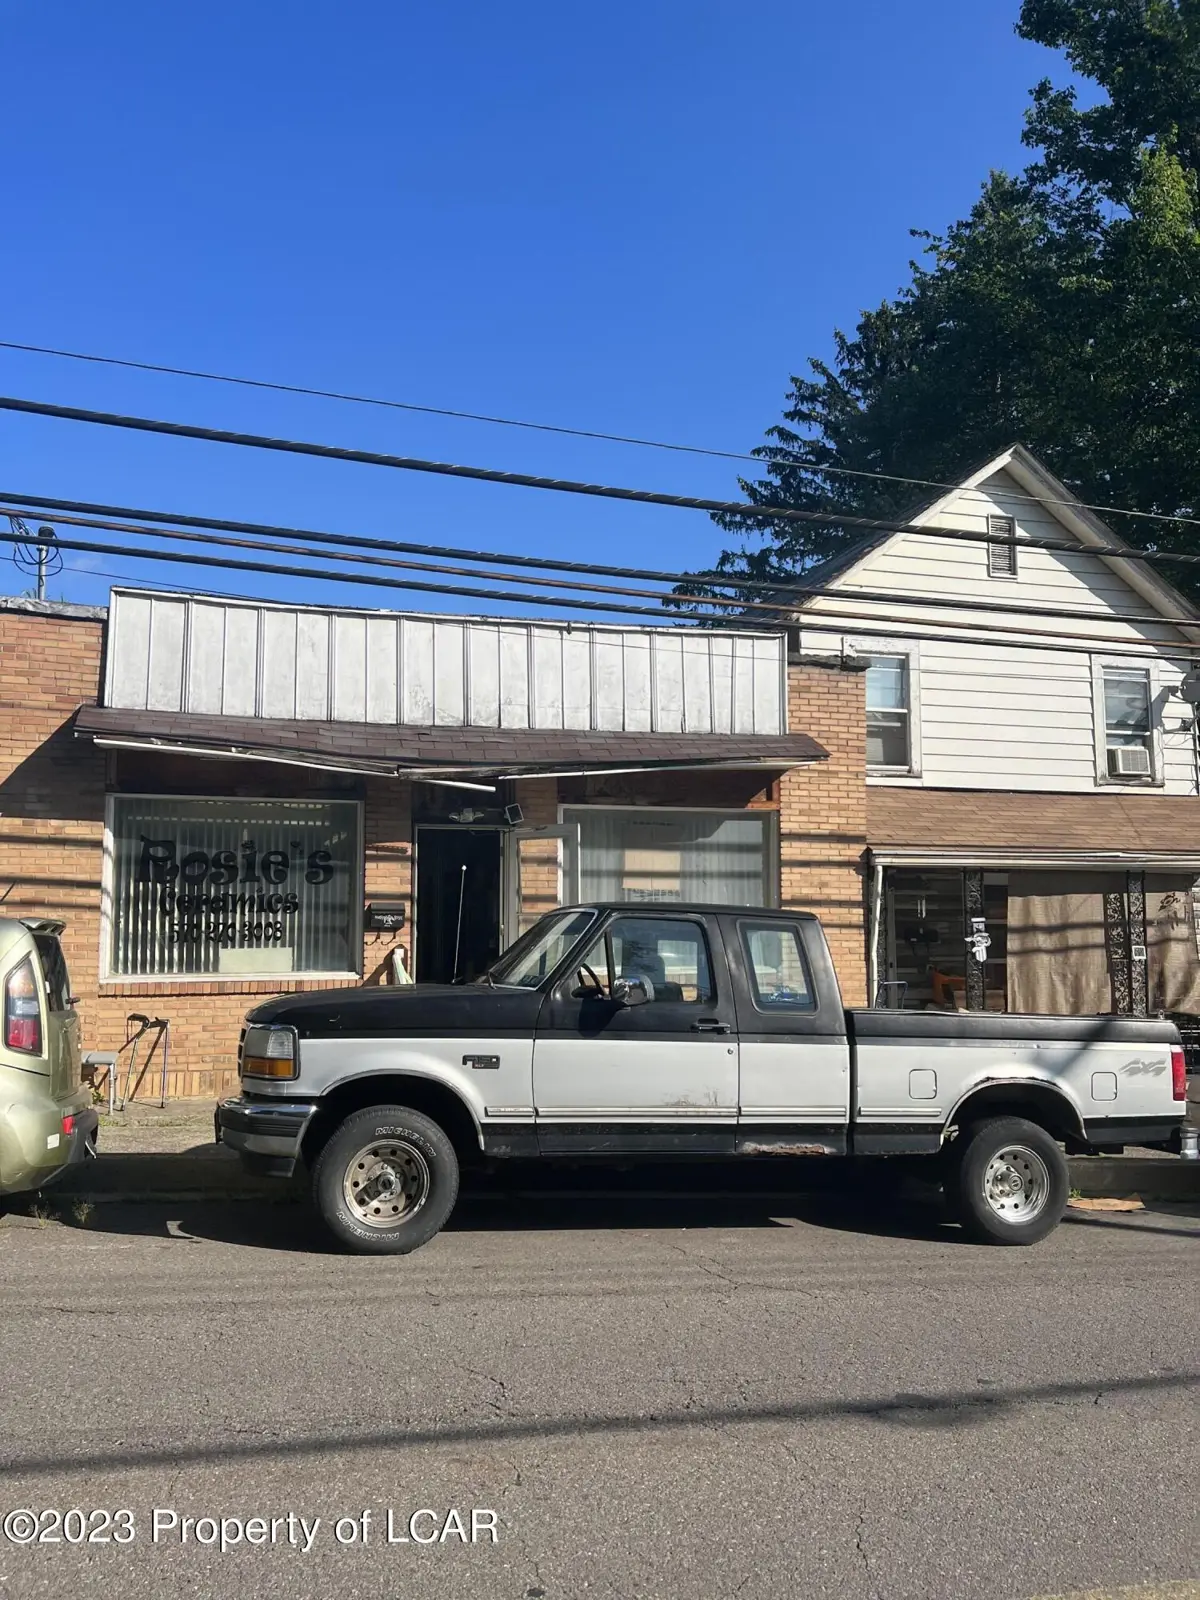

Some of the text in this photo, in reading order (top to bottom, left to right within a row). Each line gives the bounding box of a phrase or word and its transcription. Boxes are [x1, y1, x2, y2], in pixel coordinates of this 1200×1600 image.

[136, 834, 334, 885] Rosie's
[159, 887, 299, 916] Ceramics
[375, 1126, 437, 1158] MICHELIN
[336, 1210, 400, 1241] MICHELIN
